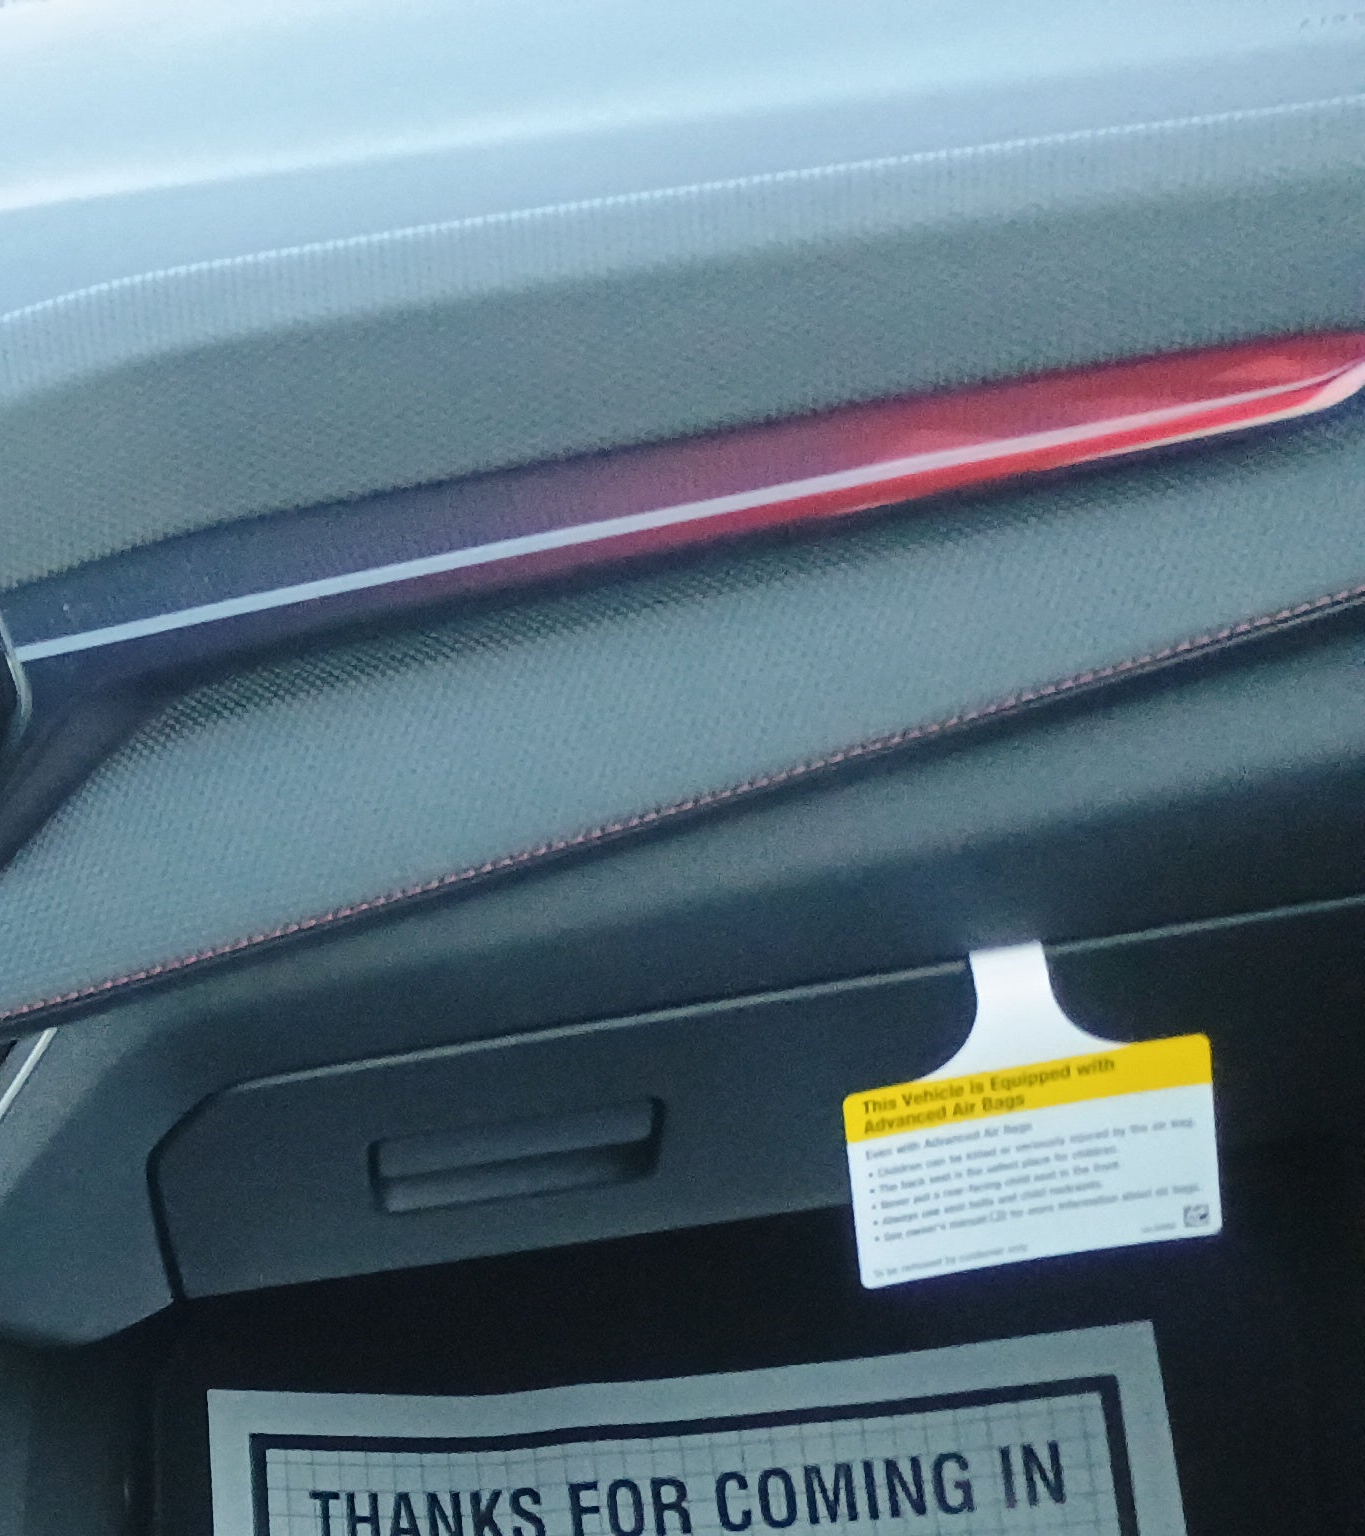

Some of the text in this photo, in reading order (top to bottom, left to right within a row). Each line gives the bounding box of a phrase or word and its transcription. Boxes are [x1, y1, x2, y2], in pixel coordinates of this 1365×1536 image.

[863, 1058, 1115, 1115] This Vehicle is Equipped with
[864, 1093, 1026, 1134] Advanced Air Bags
[714, 1451, 978, 1533] COMING
[999, 1440, 1067, 1509] IN
